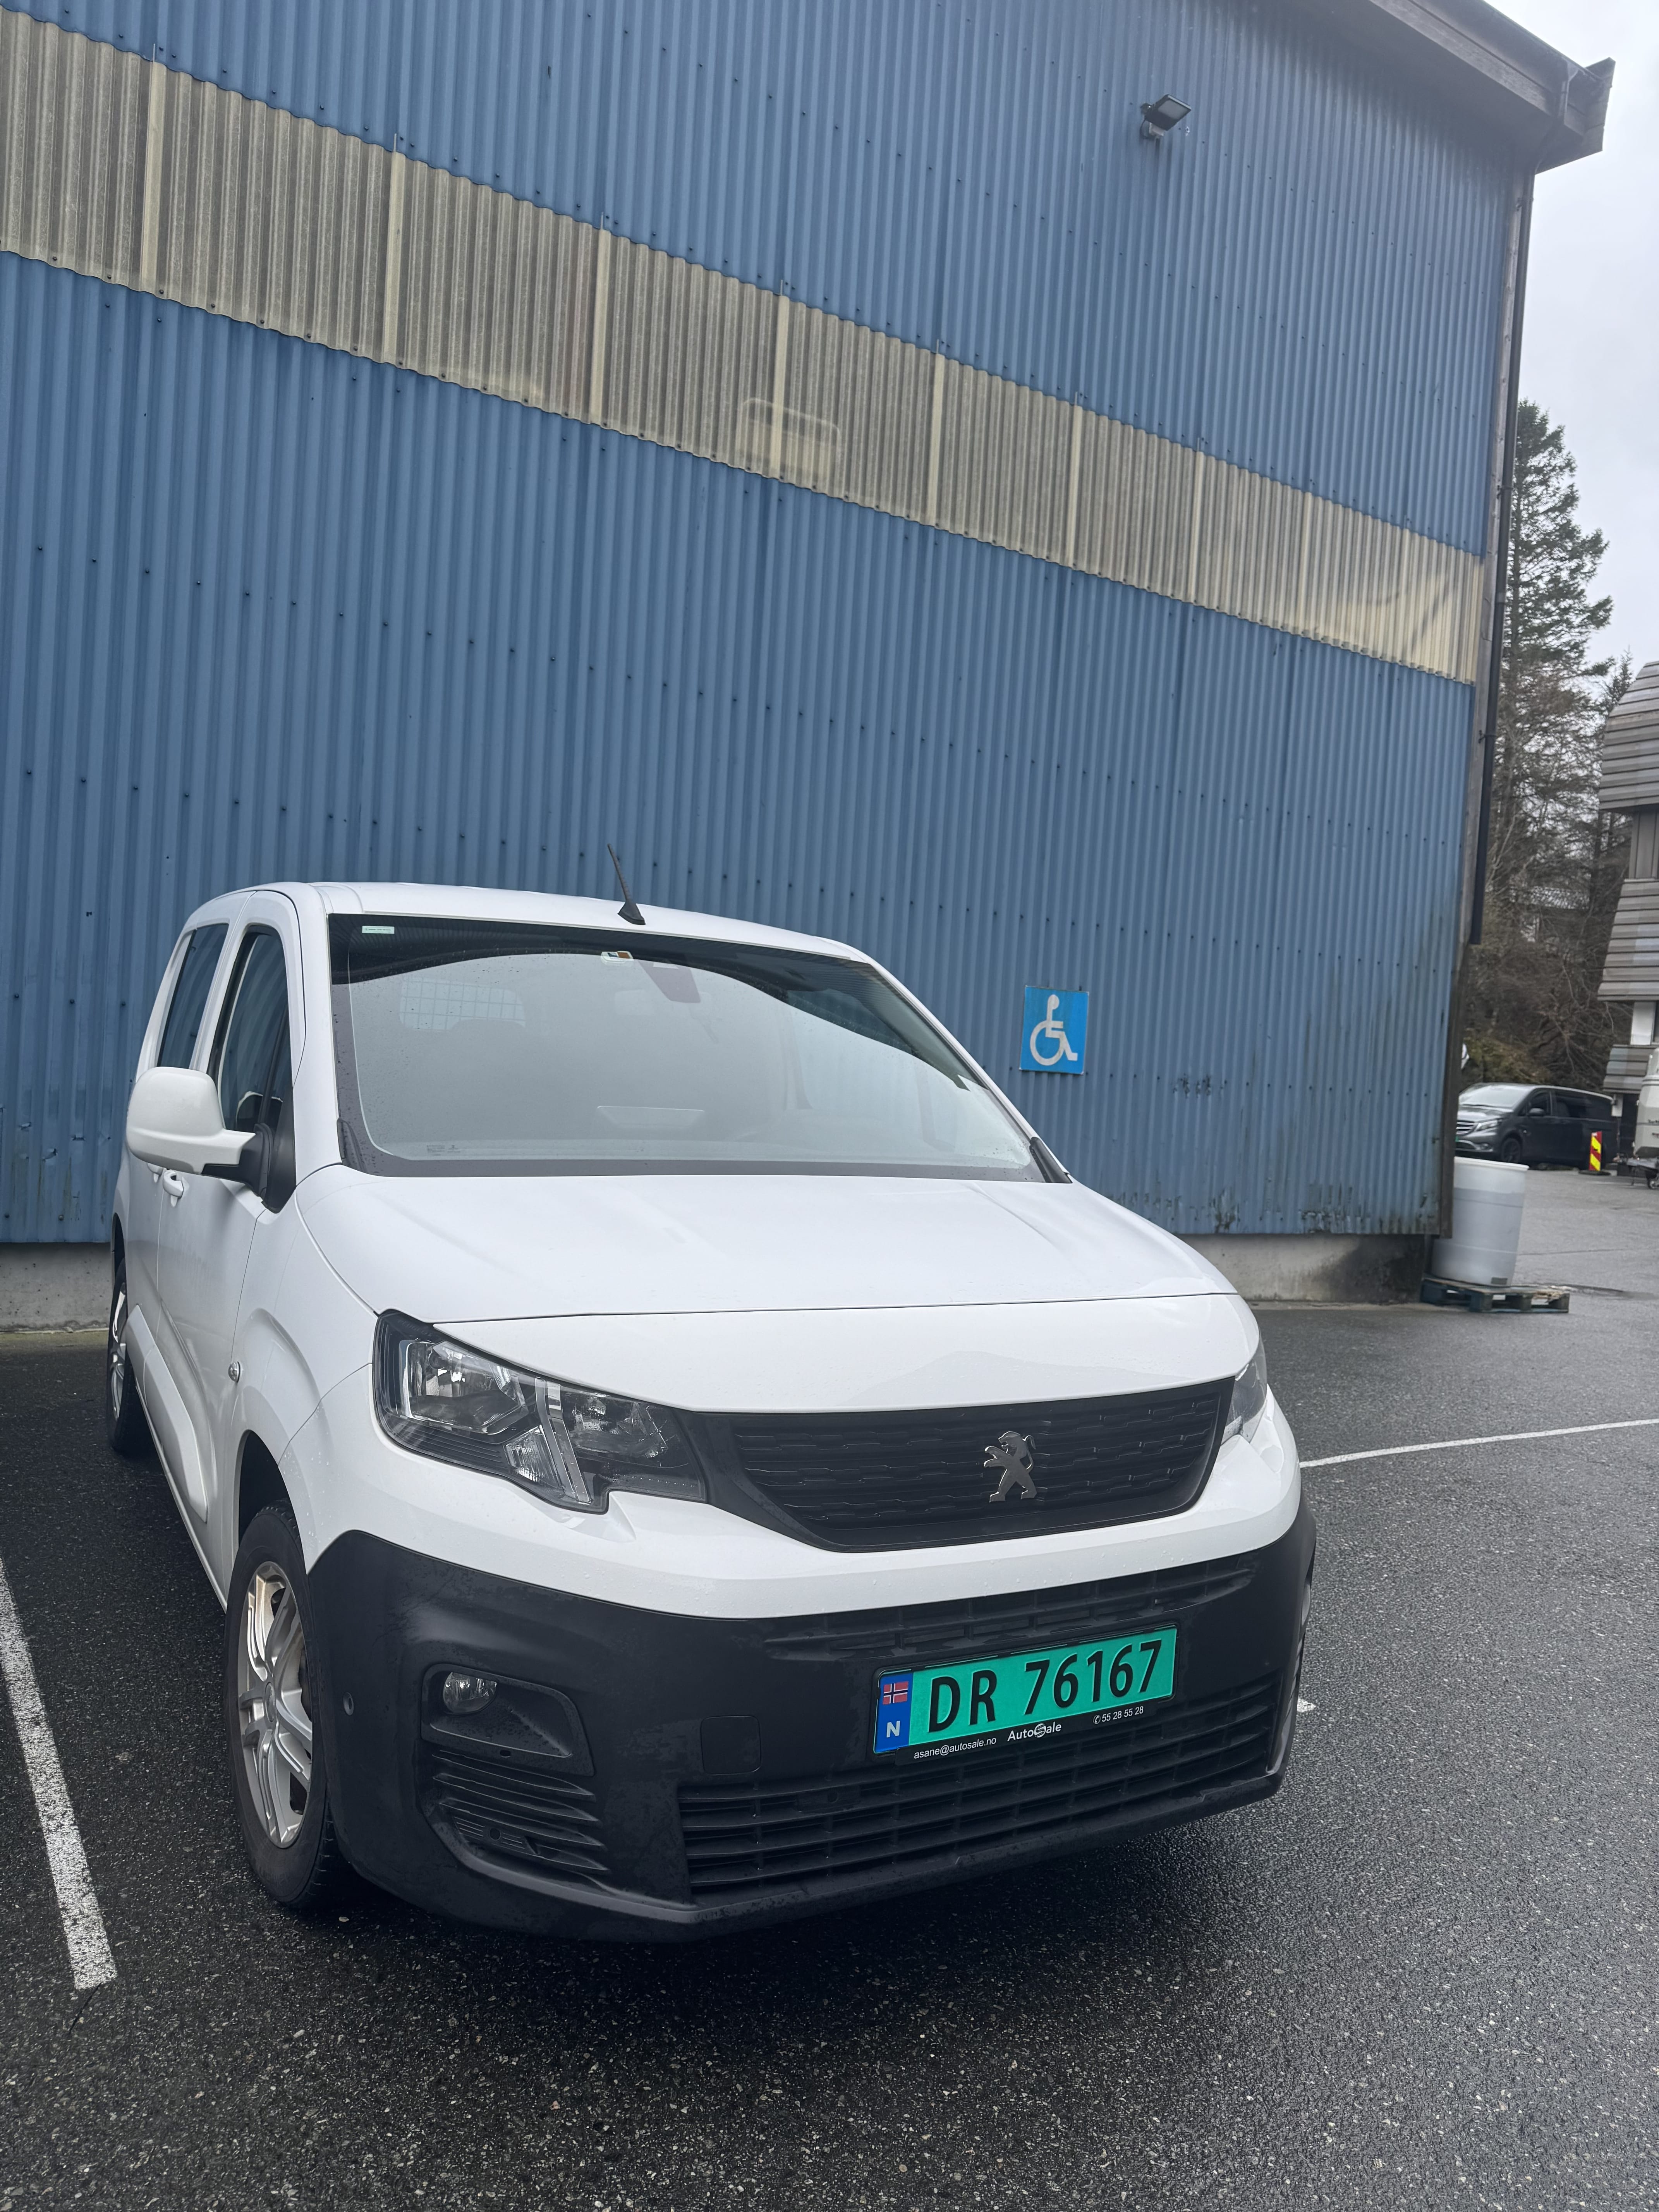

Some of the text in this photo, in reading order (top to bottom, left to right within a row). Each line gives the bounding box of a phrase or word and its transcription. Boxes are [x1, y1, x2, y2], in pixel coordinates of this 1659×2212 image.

[929, 1639, 1162, 1733] DR 76167
[1102, 1706, 1144, 1722] 55 28 55 28
[886, 1721, 900, 1738] N
[1007, 1721, 1061, 1741] AutoSale
[914, 1738, 996, 1759] asane@autosale.no
